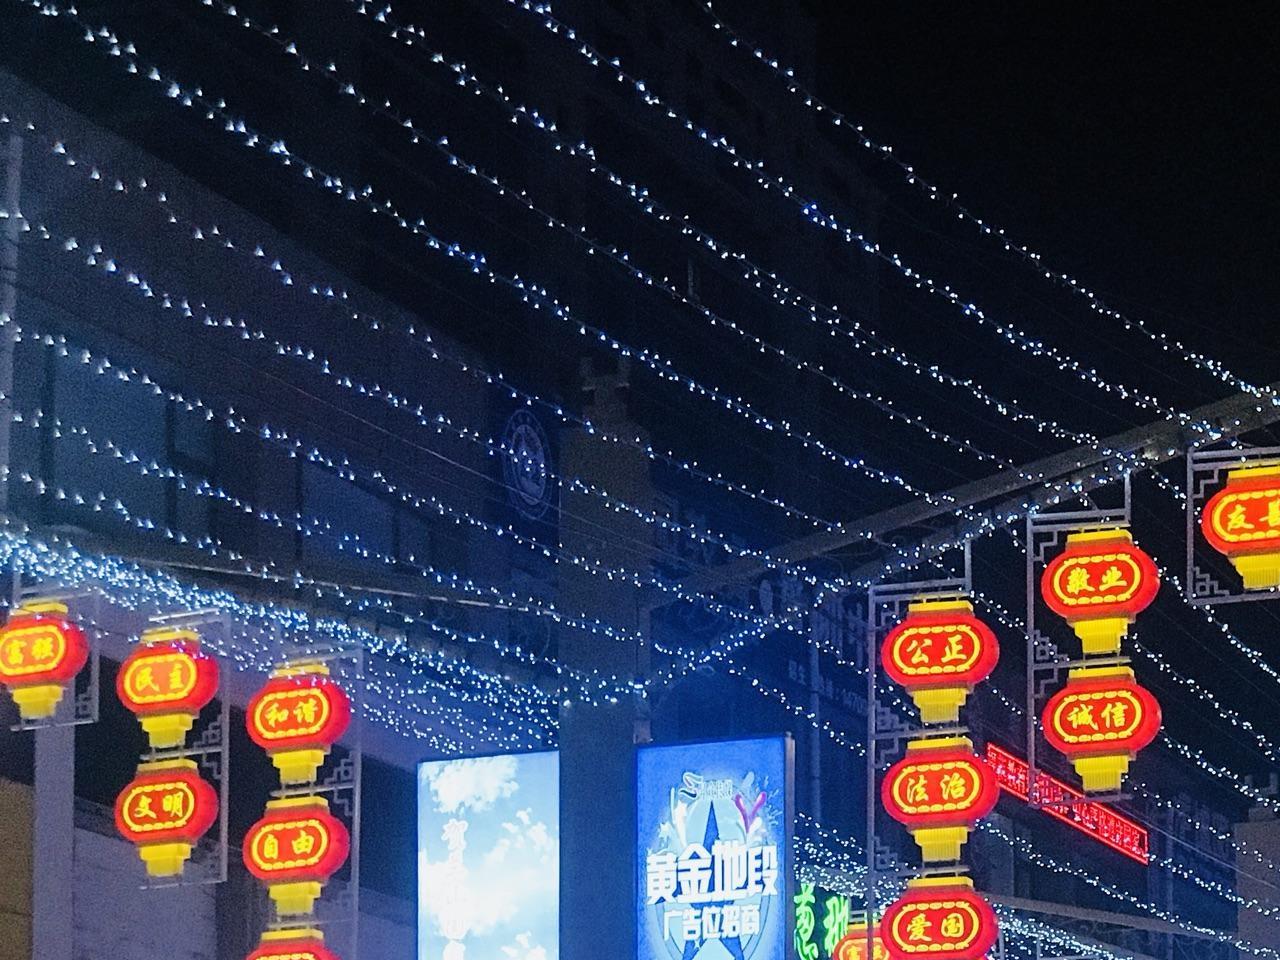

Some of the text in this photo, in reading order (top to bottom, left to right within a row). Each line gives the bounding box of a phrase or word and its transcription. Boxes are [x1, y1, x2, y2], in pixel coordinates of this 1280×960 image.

[1066, 566, 1128, 594] 敬业
[4, 637, 55, 662] 富强
[906, 634, 967, 665] 公正
[135, 664, 186, 693] 民主
[264, 700, 318, 726] 和谐
[1066, 701, 1128, 732] 诚信
[906, 774, 968, 802] 法治
[134, 793, 184, 819] 文明
[263, 830, 316, 859] 自由
[647, 839, 778, 905] 黄金地段
[664, 904, 760, 940] 广告位招商
[906, 914, 964, 942] 爱国
